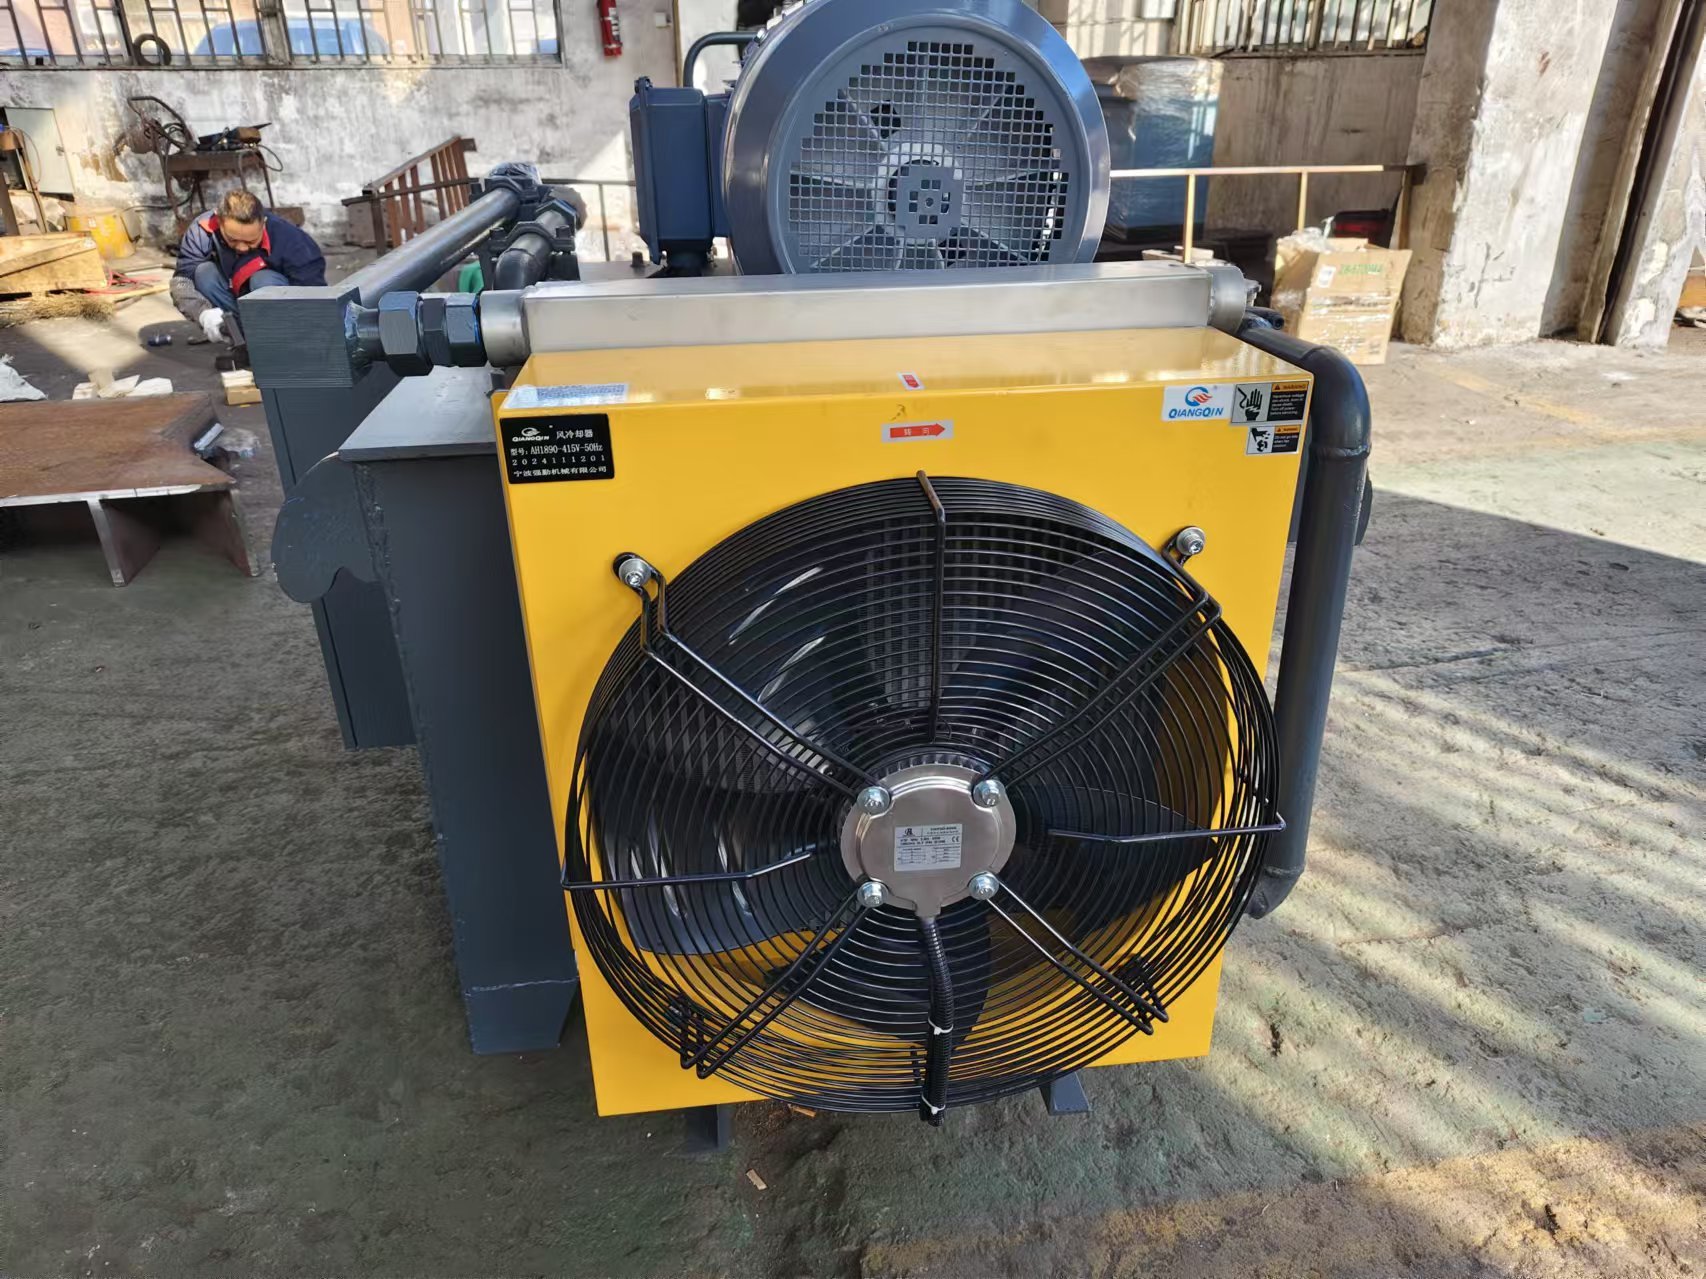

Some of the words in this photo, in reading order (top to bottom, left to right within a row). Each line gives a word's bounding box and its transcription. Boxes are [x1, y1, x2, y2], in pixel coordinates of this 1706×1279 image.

[1168, 407, 1224, 419] QIANGQIN
[556, 429, 593, 439] 风冷却器
[530, 443, 603, 455] AH1890-415V-50Hz
